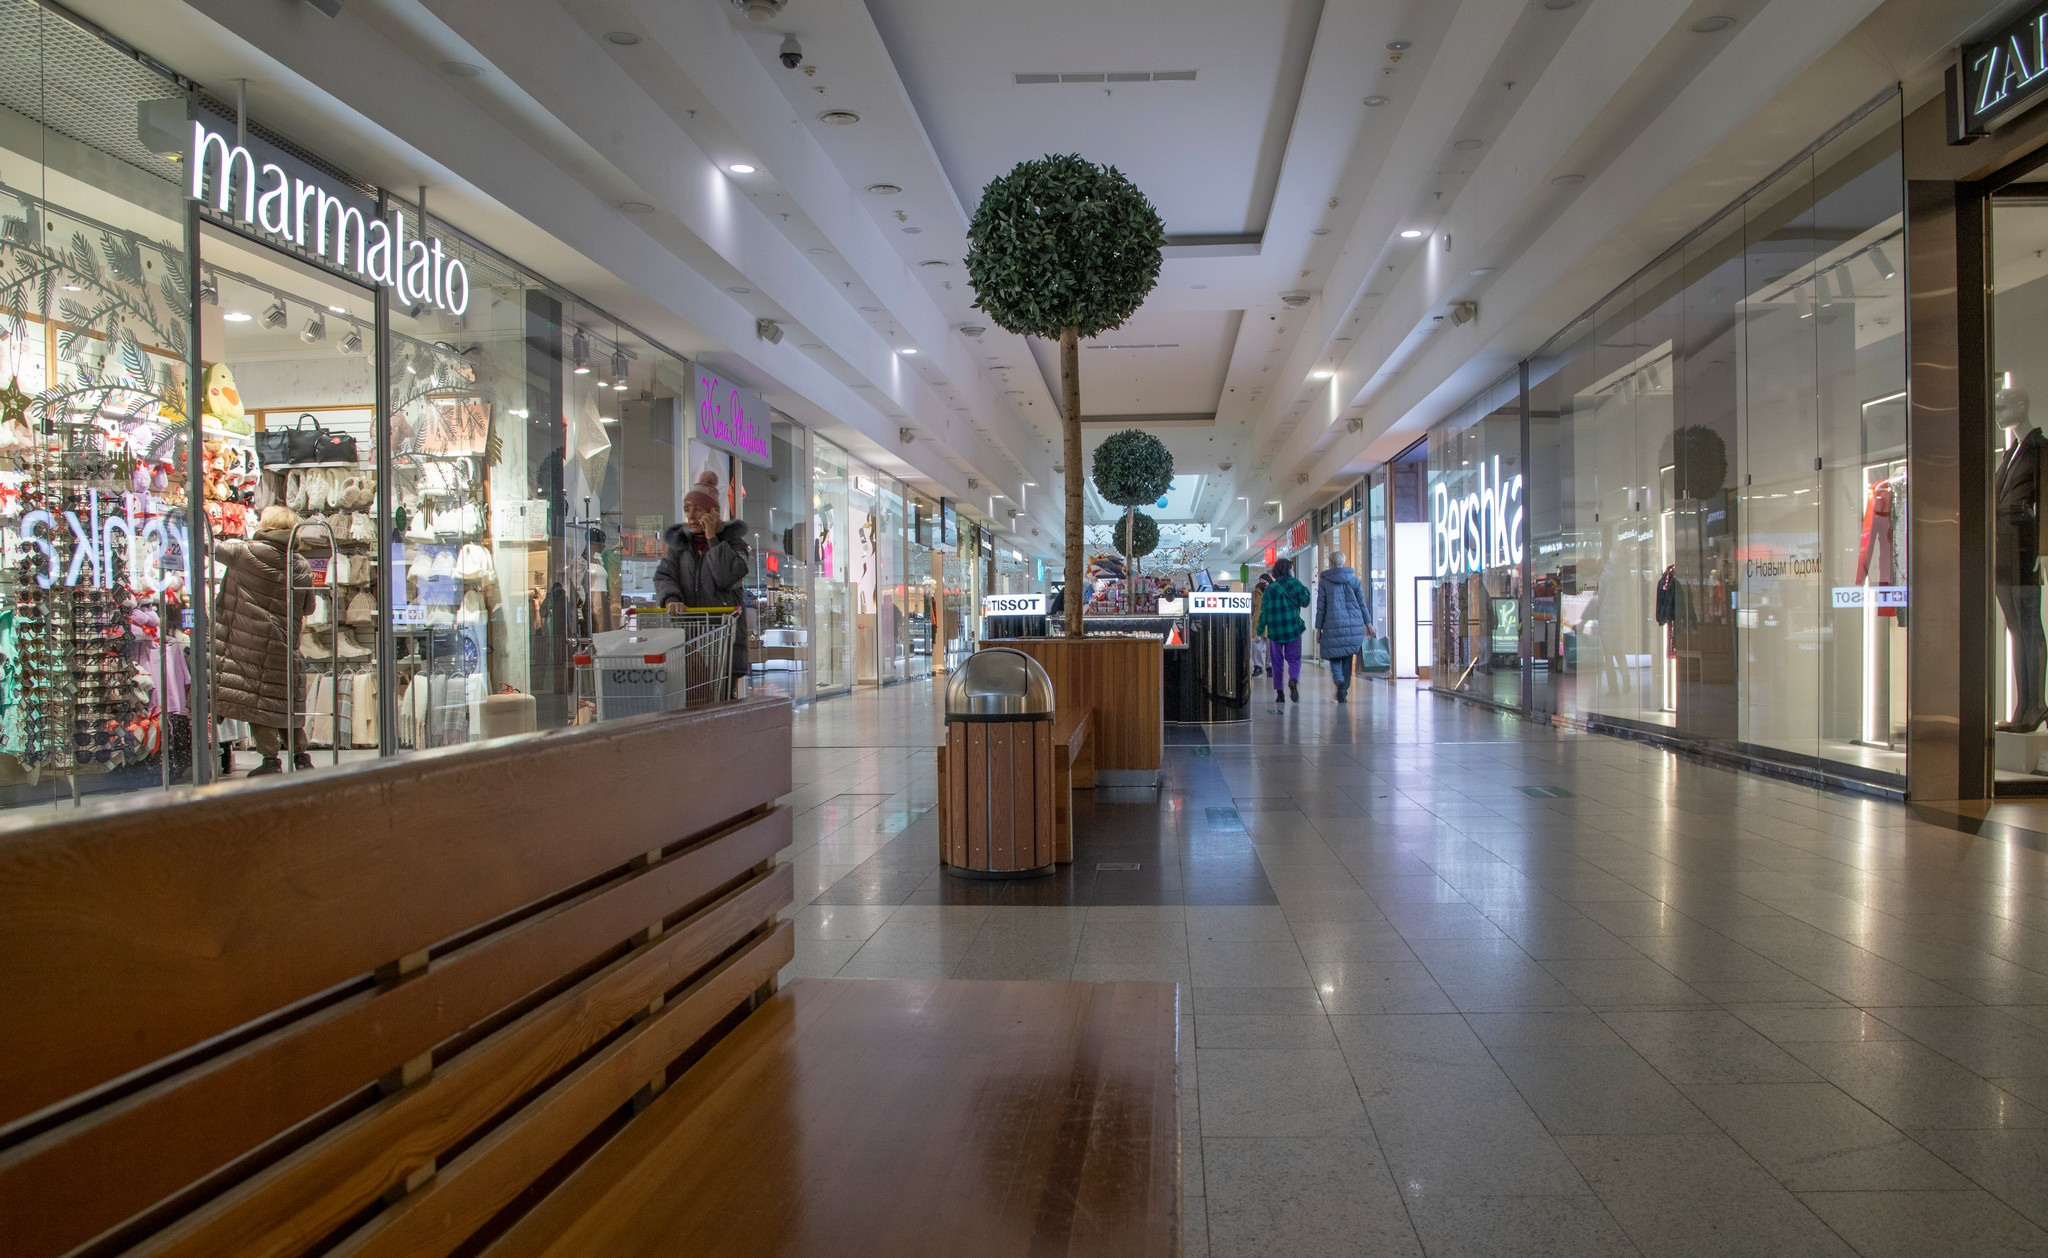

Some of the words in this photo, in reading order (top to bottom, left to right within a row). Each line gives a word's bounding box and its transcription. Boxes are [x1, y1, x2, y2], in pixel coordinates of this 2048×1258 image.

[192, 120, 469, 316] marmalato
[1435, 454, 1523, 577] Bershka
[1755, 558, 1787, 578] Новым
[1789, 552, 1823, 580] Годом!
[991, 598, 1040, 611] TISSOT
[613, 669, 667, 684] ecco
